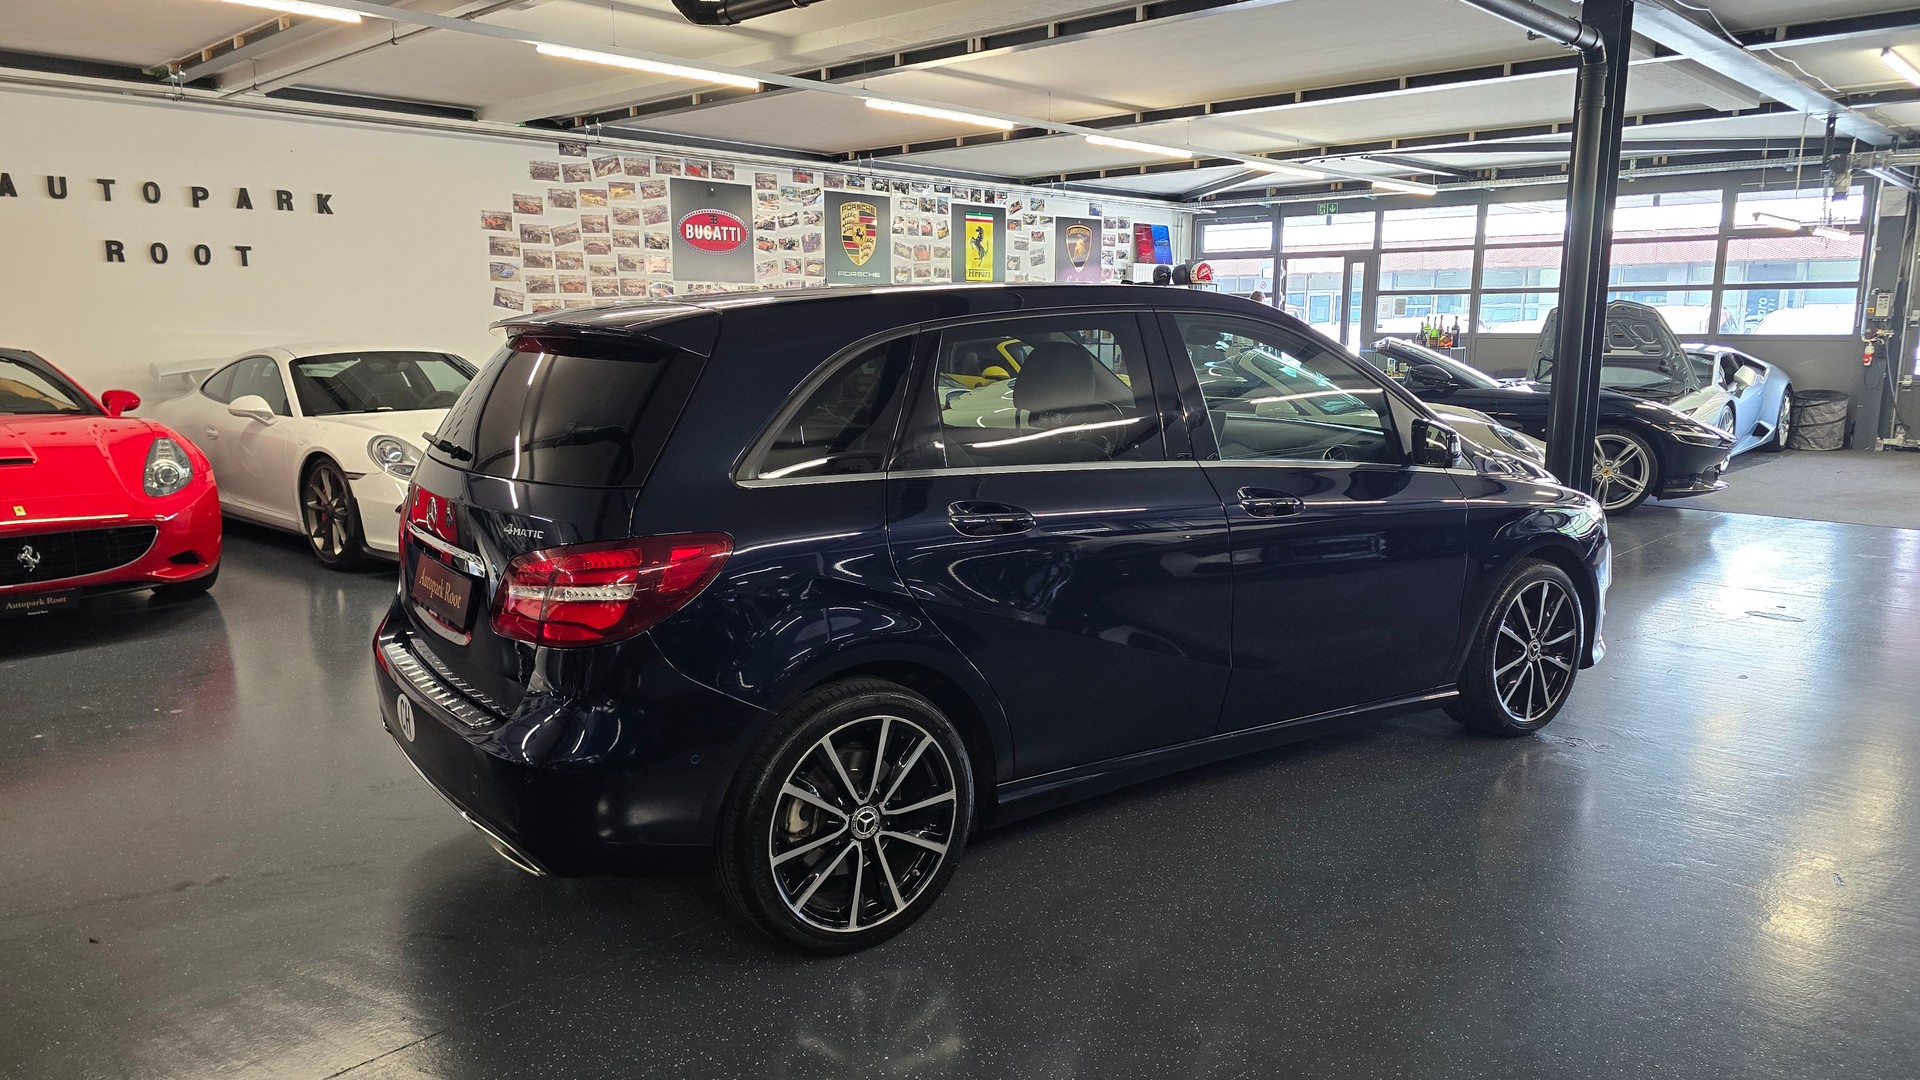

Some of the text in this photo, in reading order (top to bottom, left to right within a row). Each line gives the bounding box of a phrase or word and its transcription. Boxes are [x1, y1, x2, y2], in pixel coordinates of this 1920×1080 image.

[0, 173, 334, 215] AUTOPARK
[685, 223, 741, 242] BUGATTI
[105, 240, 252, 267] ROOT
[837, 270, 881, 278] PORSCHE
[419, 567, 461, 608] Autopark Root
[6, 598, 45, 609] Autopark
